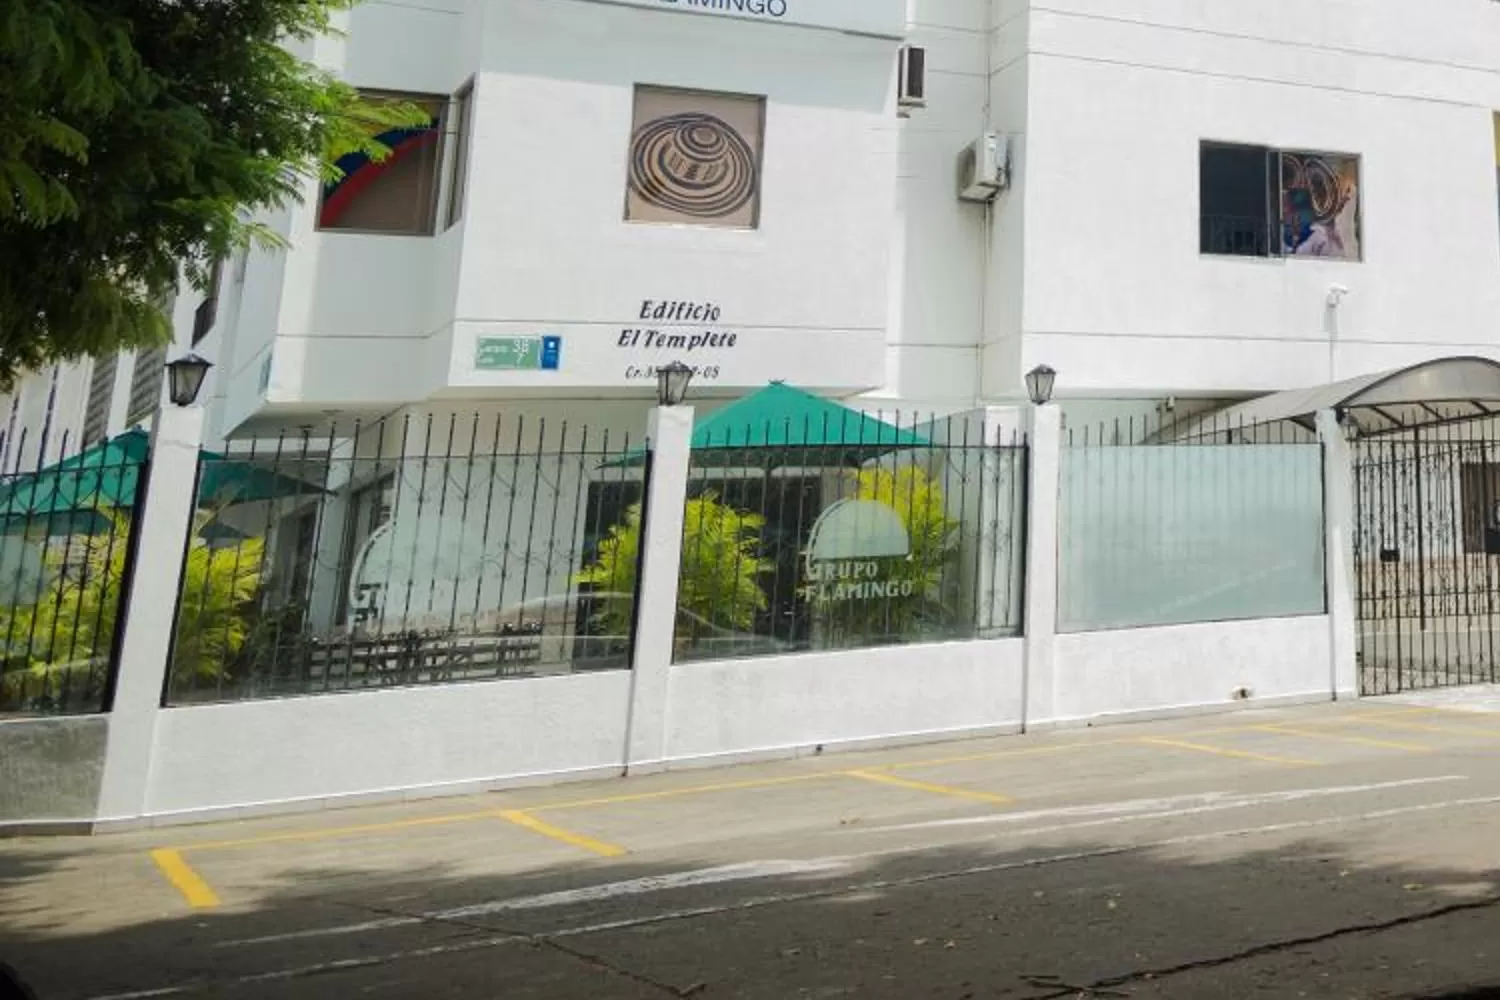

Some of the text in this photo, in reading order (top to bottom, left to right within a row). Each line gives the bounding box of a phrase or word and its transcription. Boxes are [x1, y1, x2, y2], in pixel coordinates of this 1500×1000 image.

[639, 300, 721, 321] Edificio
[617, 329, 737, 351] El Templete
[805, 560, 878, 581] GRUPO
[804, 579, 912, 603] FLAMINGO
